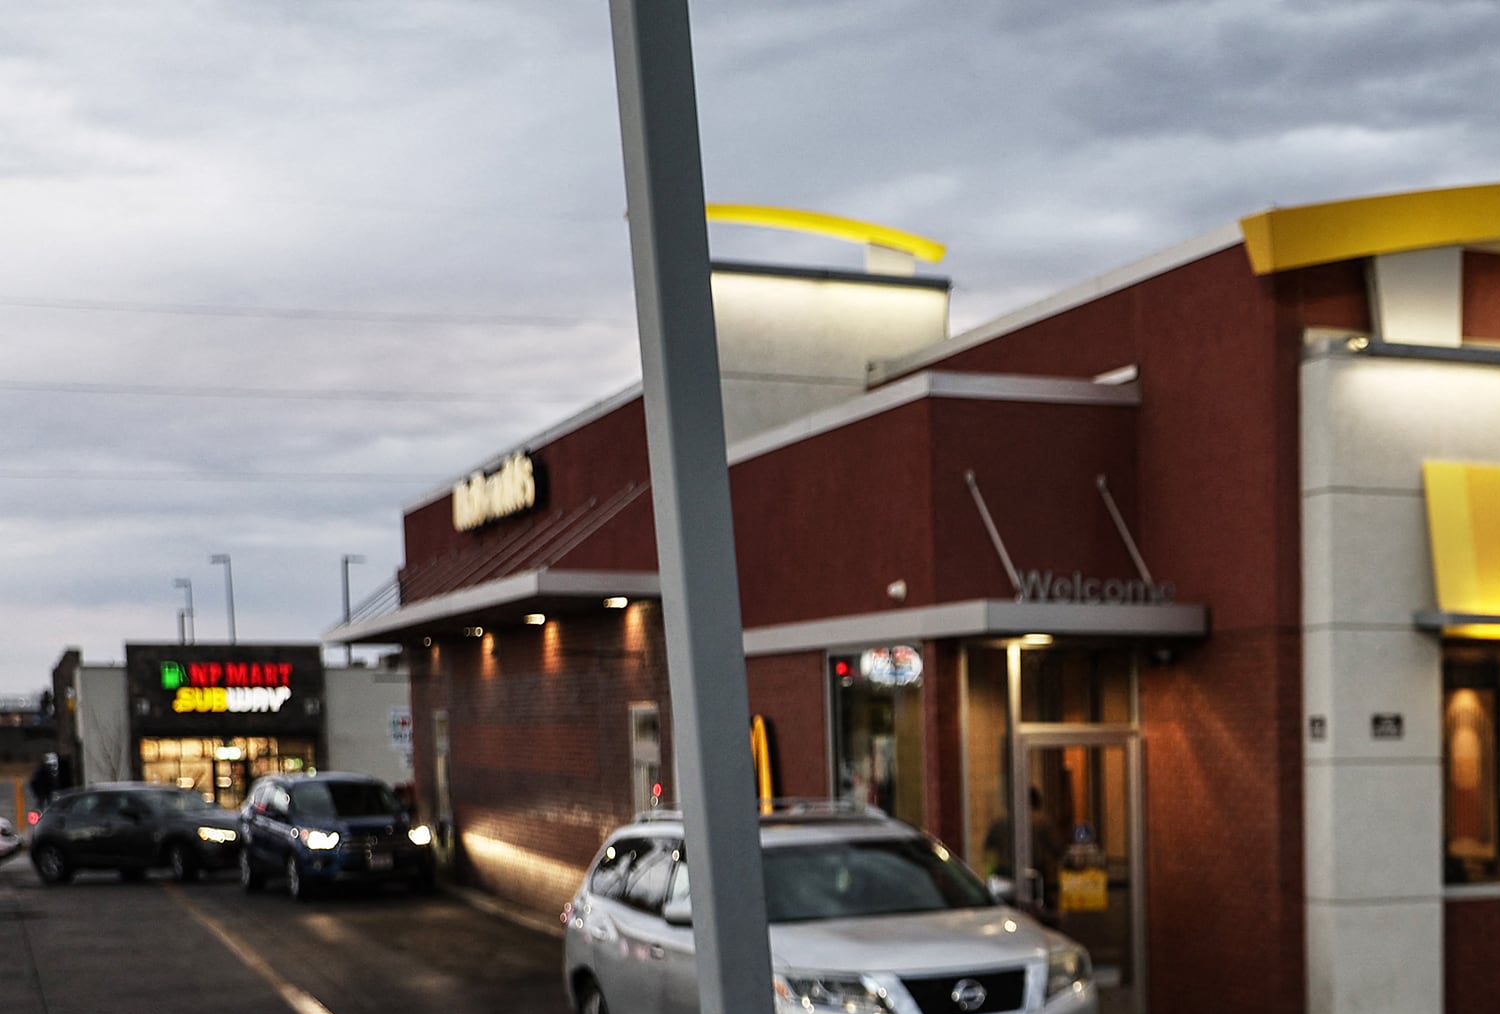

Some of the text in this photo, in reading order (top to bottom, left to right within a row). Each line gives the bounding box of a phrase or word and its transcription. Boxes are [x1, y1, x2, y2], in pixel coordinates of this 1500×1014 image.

[1018, 569, 1177, 604] Welcome
[188, 661, 293, 688] NP MART
[172, 686, 292, 713] SUBWAY
